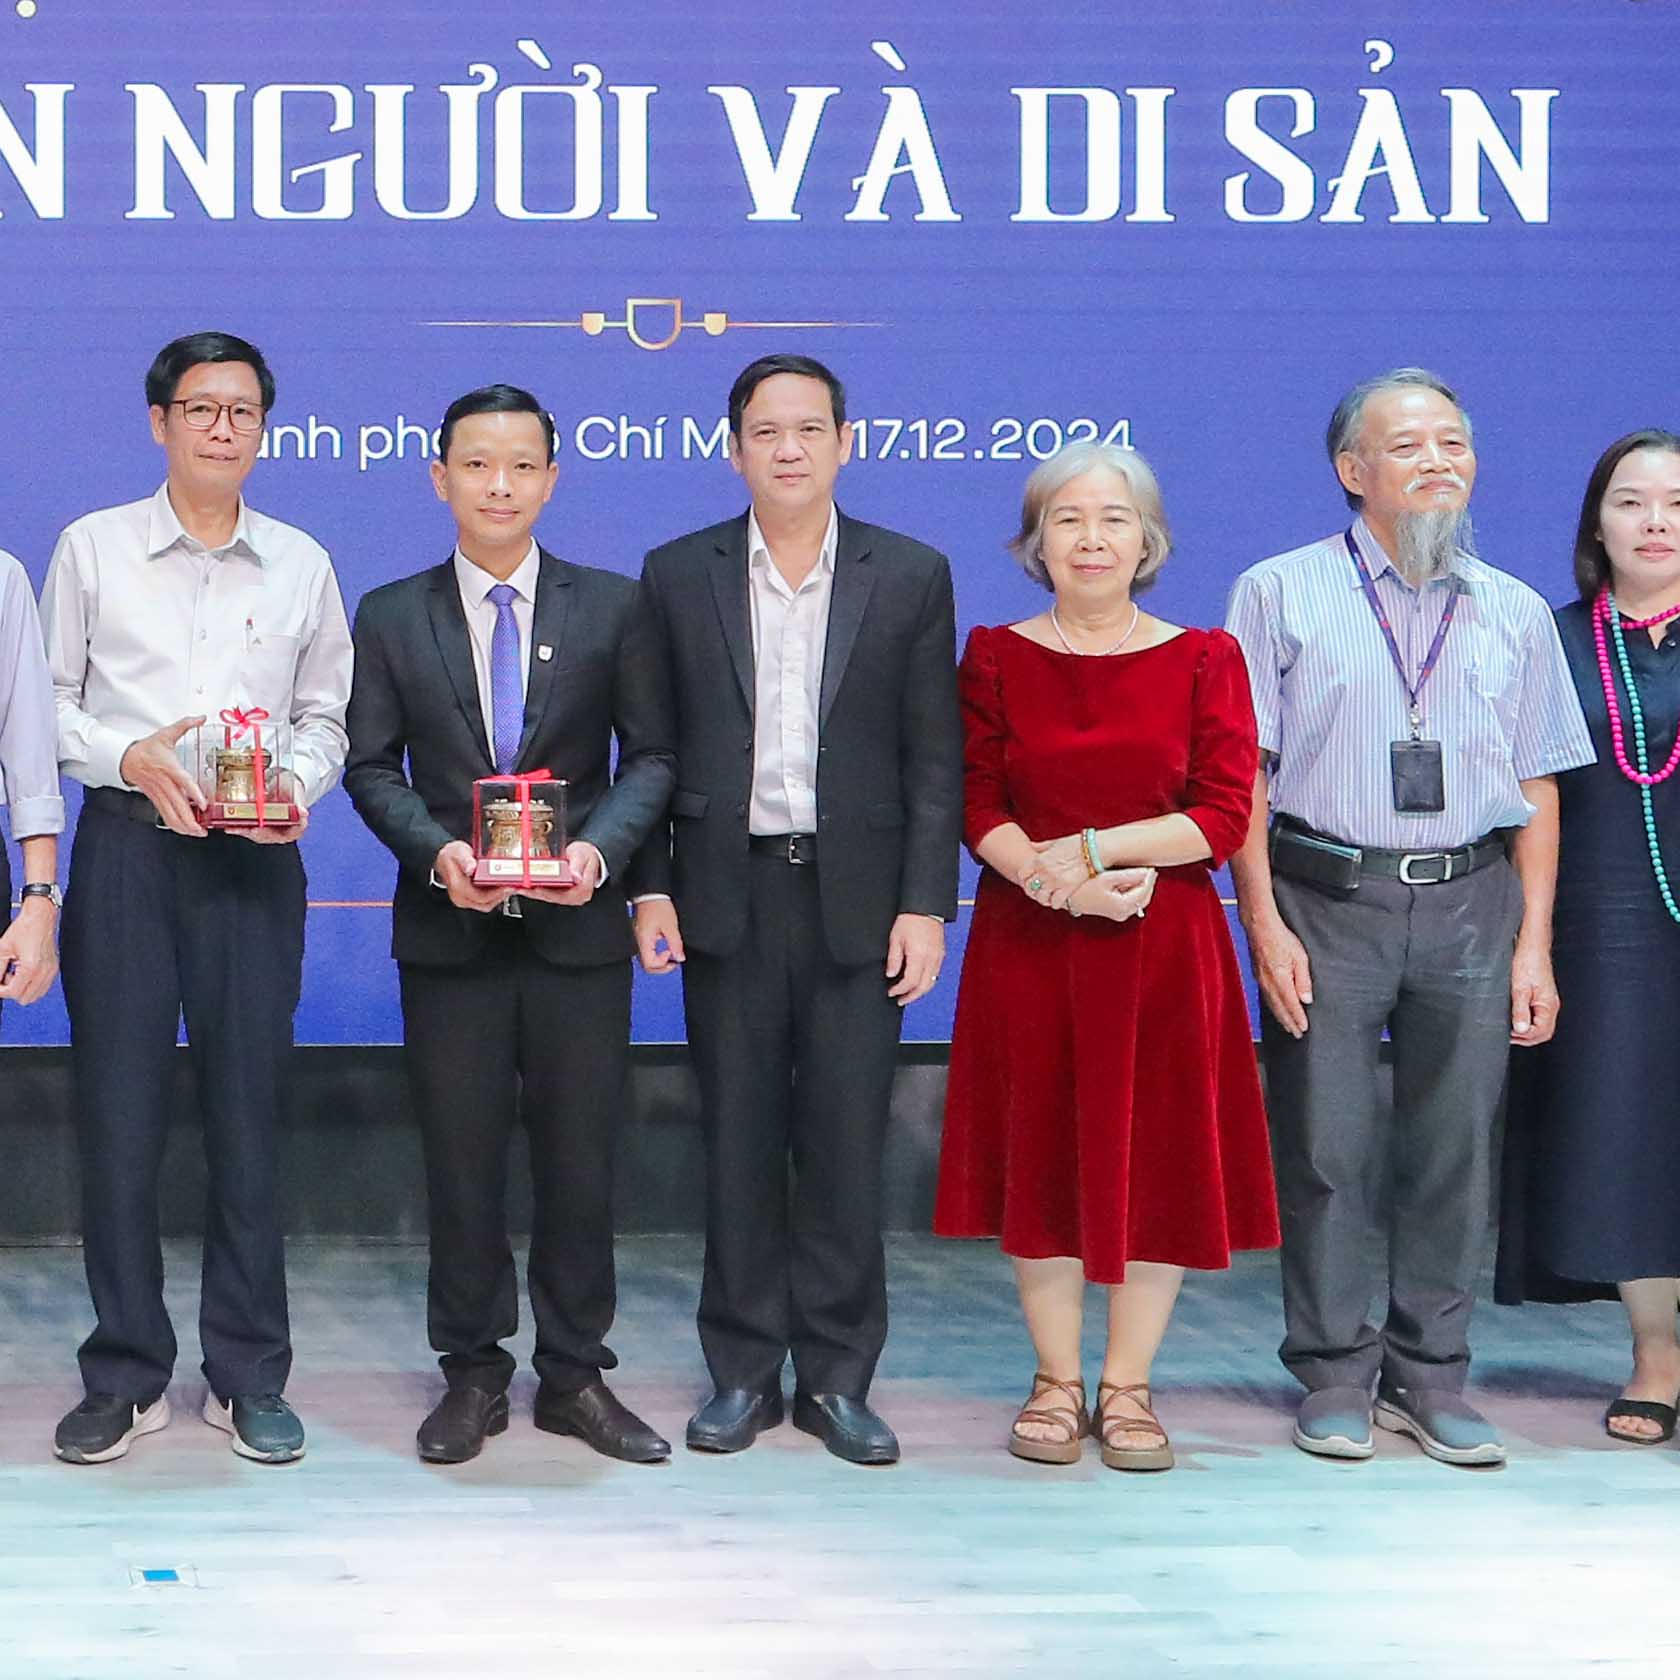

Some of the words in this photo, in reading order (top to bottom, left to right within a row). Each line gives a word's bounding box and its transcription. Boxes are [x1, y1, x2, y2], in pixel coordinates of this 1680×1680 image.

[124, 39, 659, 221] NGƯỜI
[706, 40, 963, 222] VÀ
[1009, 86, 1176, 223] DI
[1224, 39, 1561, 224] SẢN
[575, 415, 668, 460] Chí
[851, 418, 1136, 460] 17.12.2024
